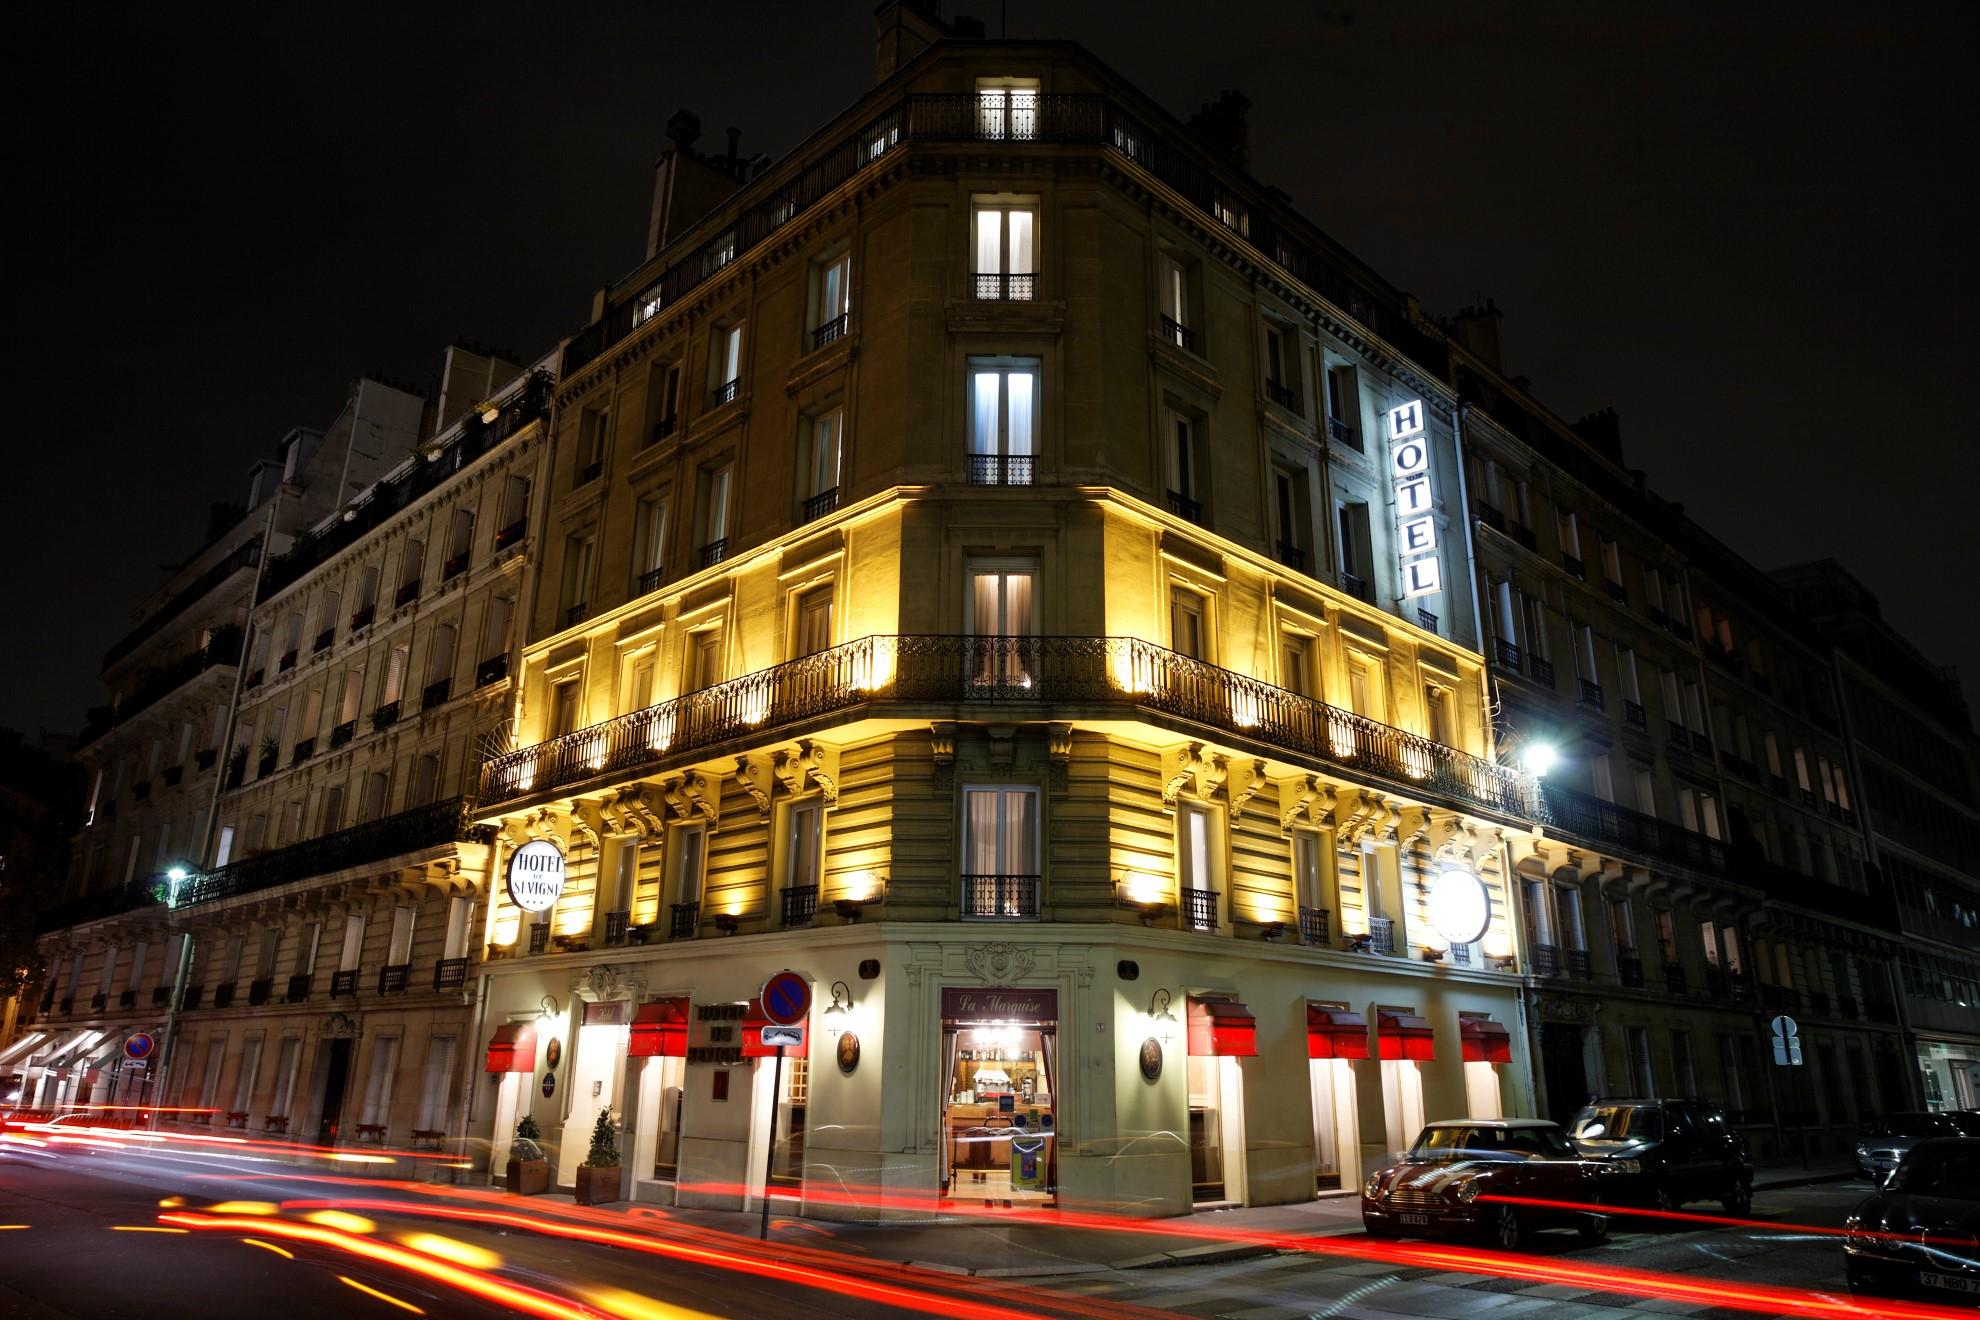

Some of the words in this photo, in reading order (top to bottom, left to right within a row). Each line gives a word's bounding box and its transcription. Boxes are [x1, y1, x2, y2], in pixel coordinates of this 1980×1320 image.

[1394, 404, 1434, 592] HOTEL
[519, 853, 563, 872] HOTEL
[960, 994, 976, 1011] La
[983, 994, 1041, 1015] Marquise
